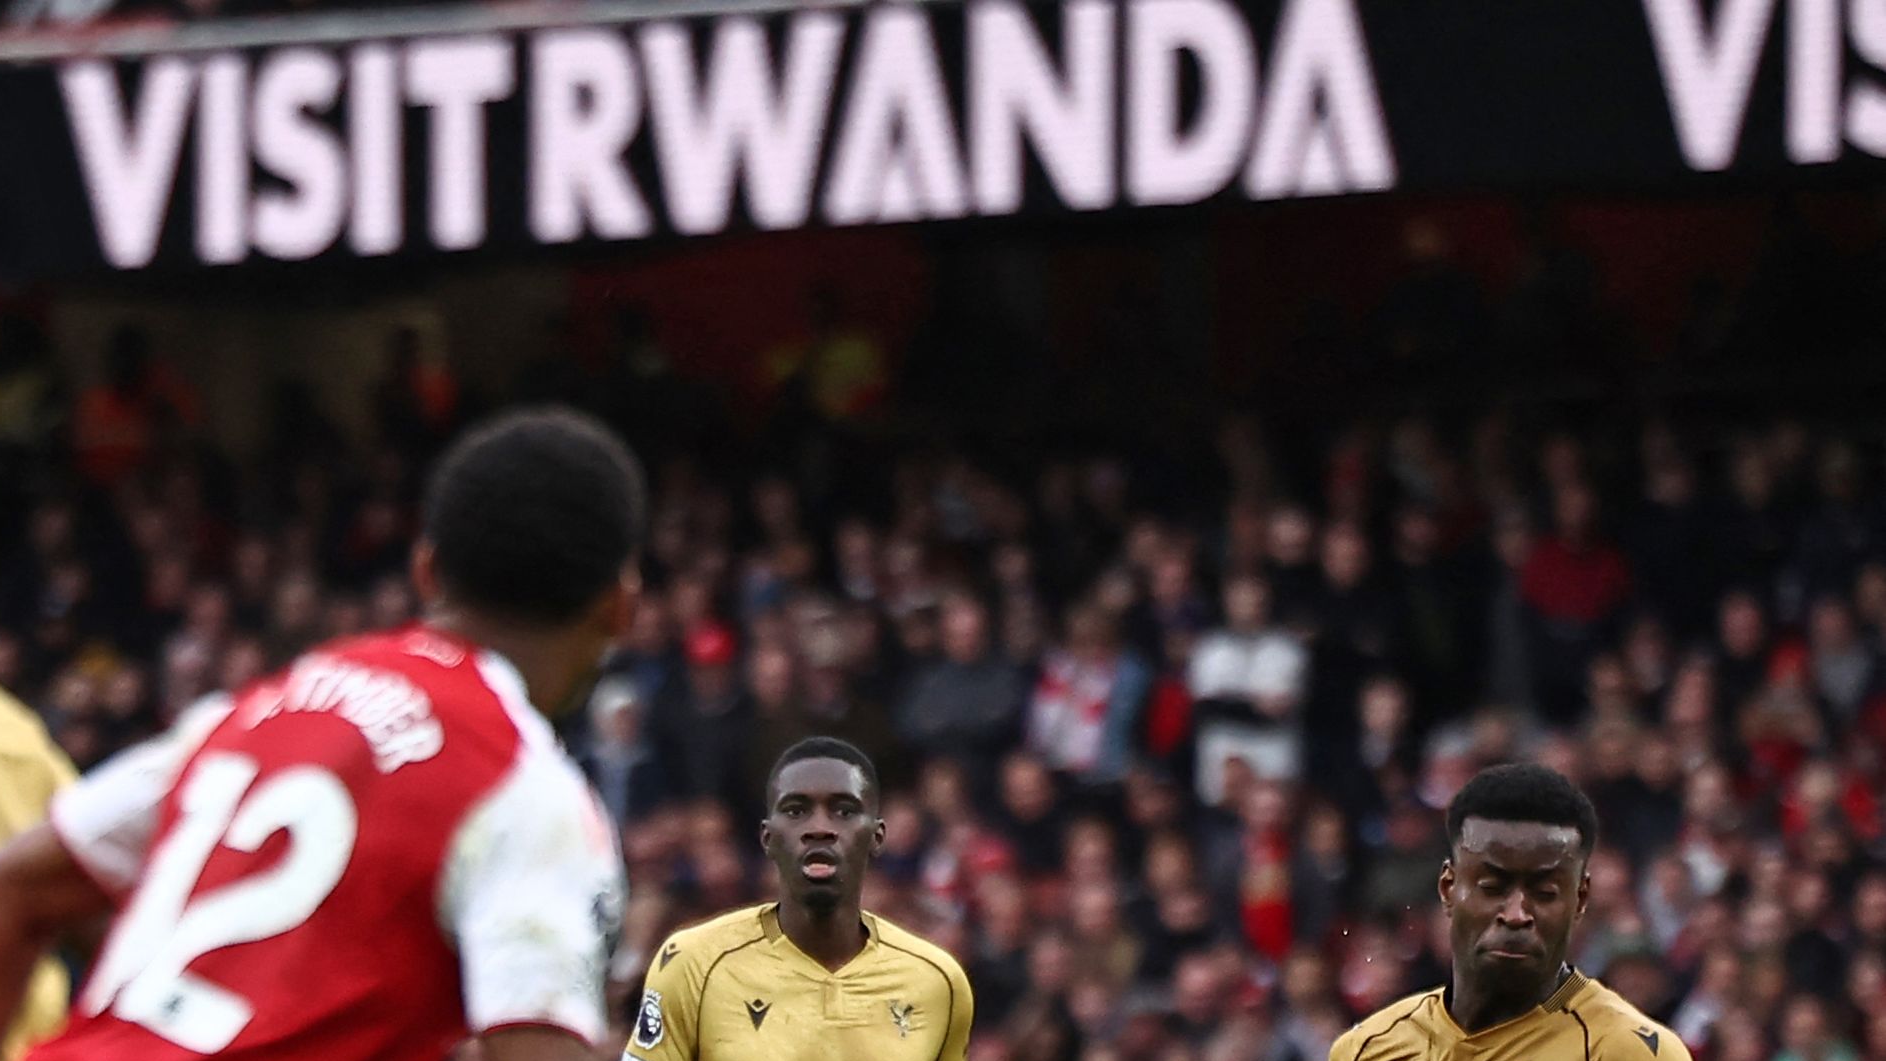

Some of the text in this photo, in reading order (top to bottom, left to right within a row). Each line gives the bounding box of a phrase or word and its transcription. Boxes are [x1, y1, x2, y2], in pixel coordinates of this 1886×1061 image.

[62, 0, 1394, 268] VISIT RWANDA
[82, 750, 358, 1055] 12
